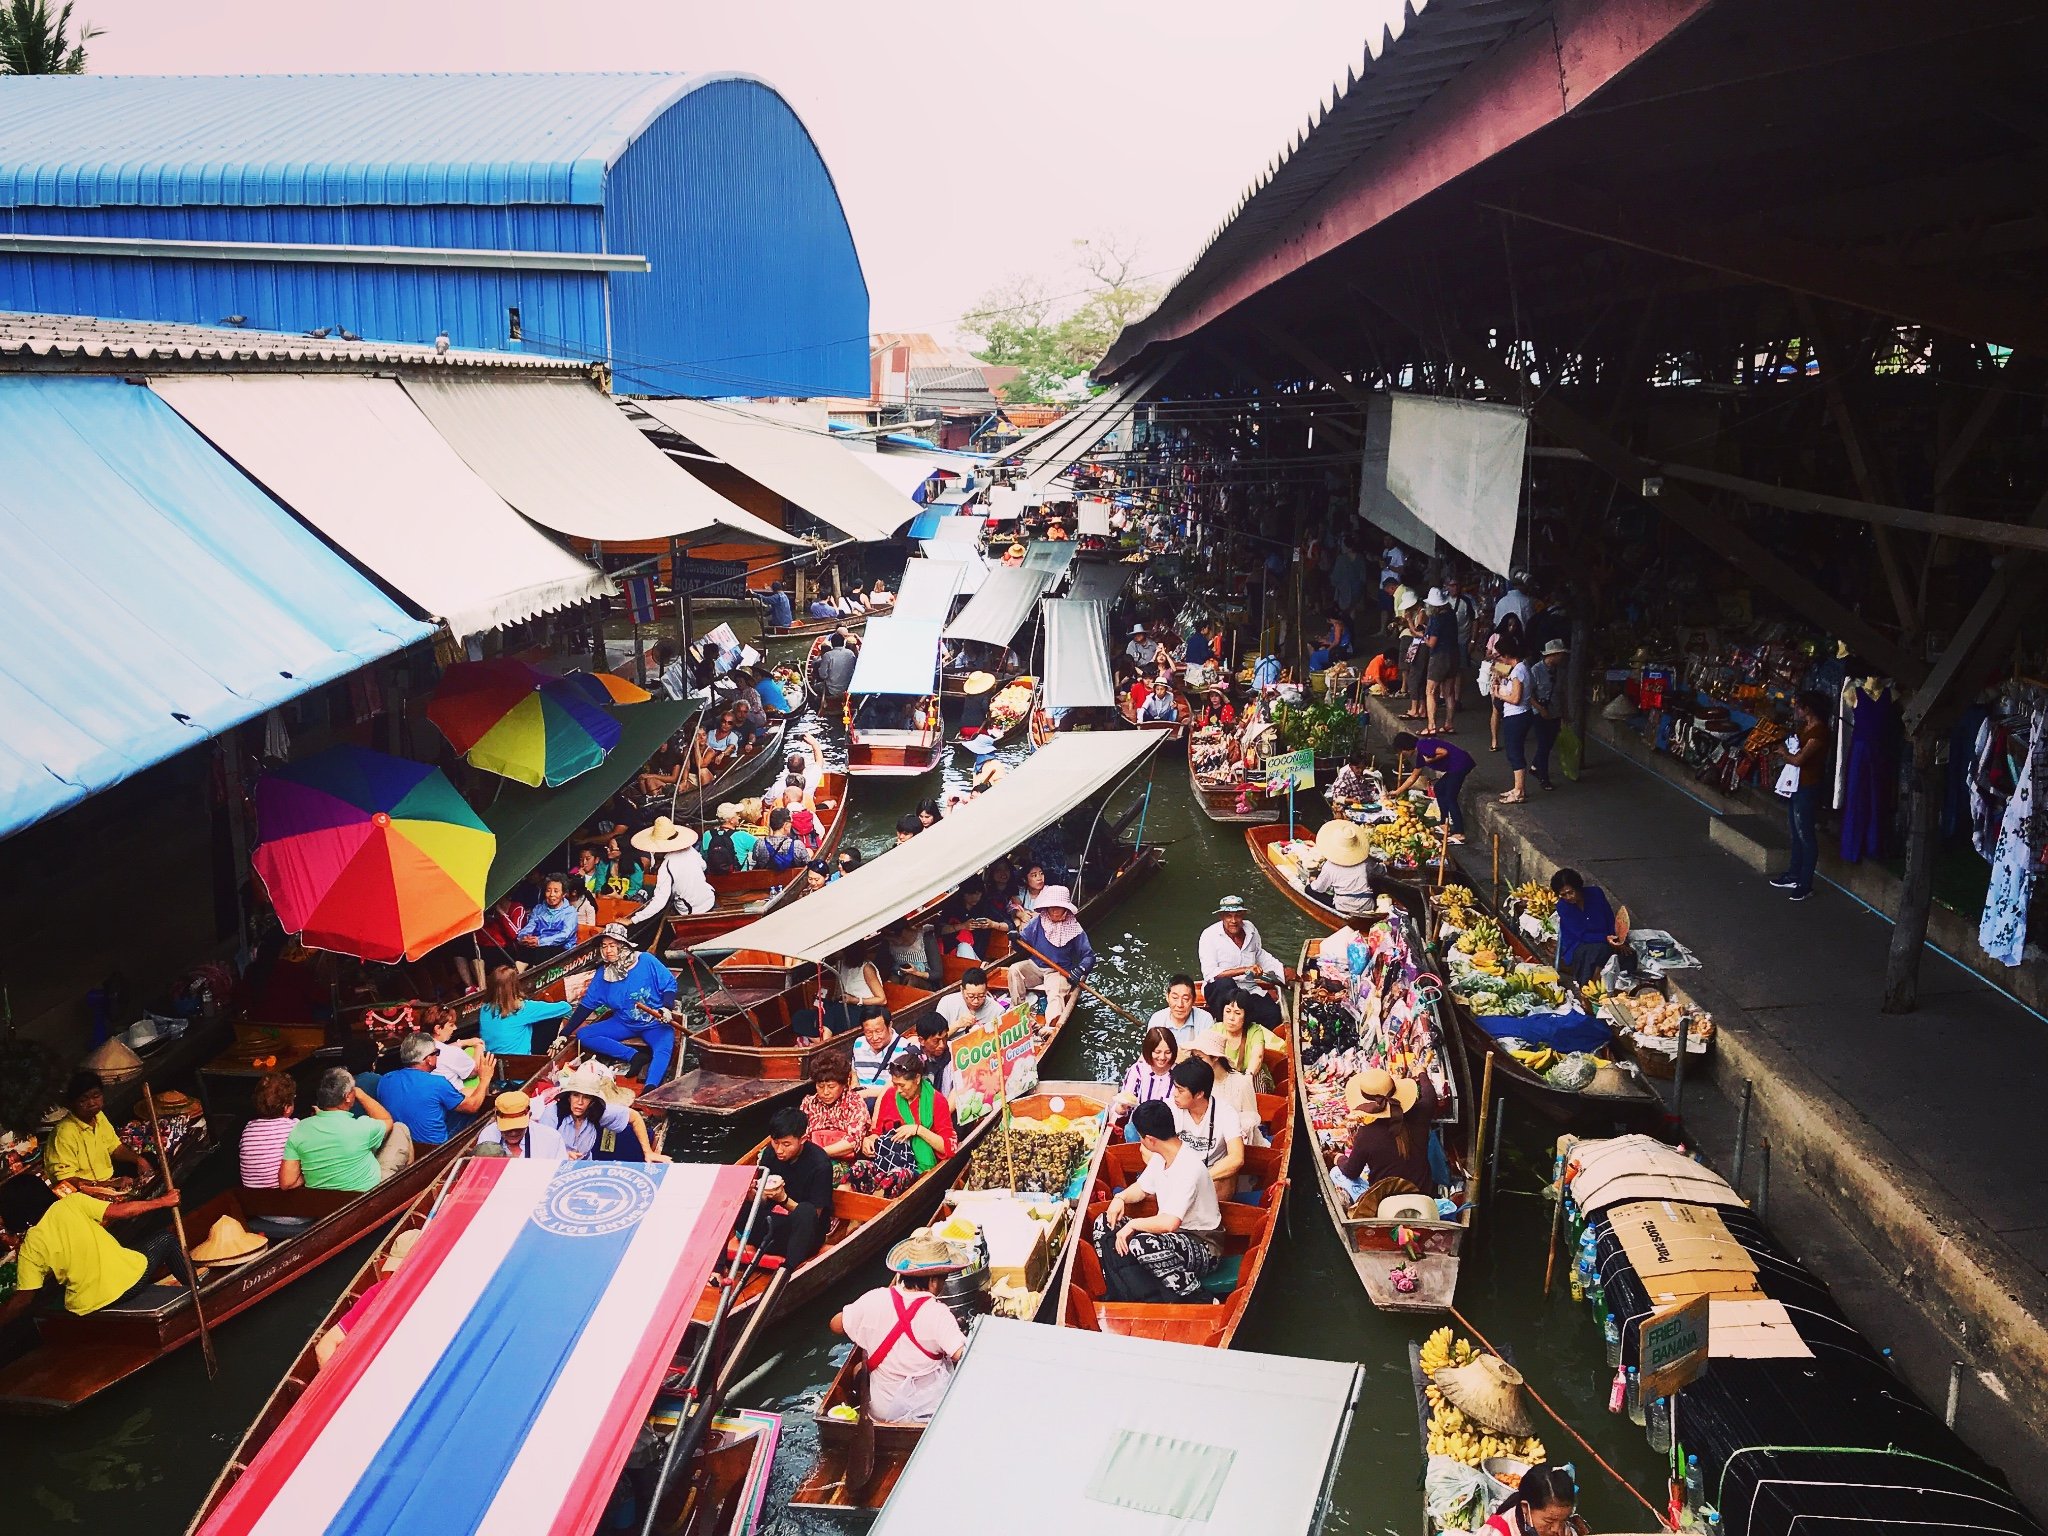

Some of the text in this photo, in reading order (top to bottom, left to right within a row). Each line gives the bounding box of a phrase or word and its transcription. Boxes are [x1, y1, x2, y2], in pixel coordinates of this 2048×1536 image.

[674, 578, 744, 597] BOAT SERVICE
[1268, 752, 1310, 768] COCONUT
[991, 1040, 1032, 1070] Ic Cream
[548, 1167, 653, 1198] FLOATING MARKET
[548, 1221, 589, 1234] BOAT
[1648, 1319, 1682, 1347] FRIED
[1652, 1330, 1697, 1365] BANANA
